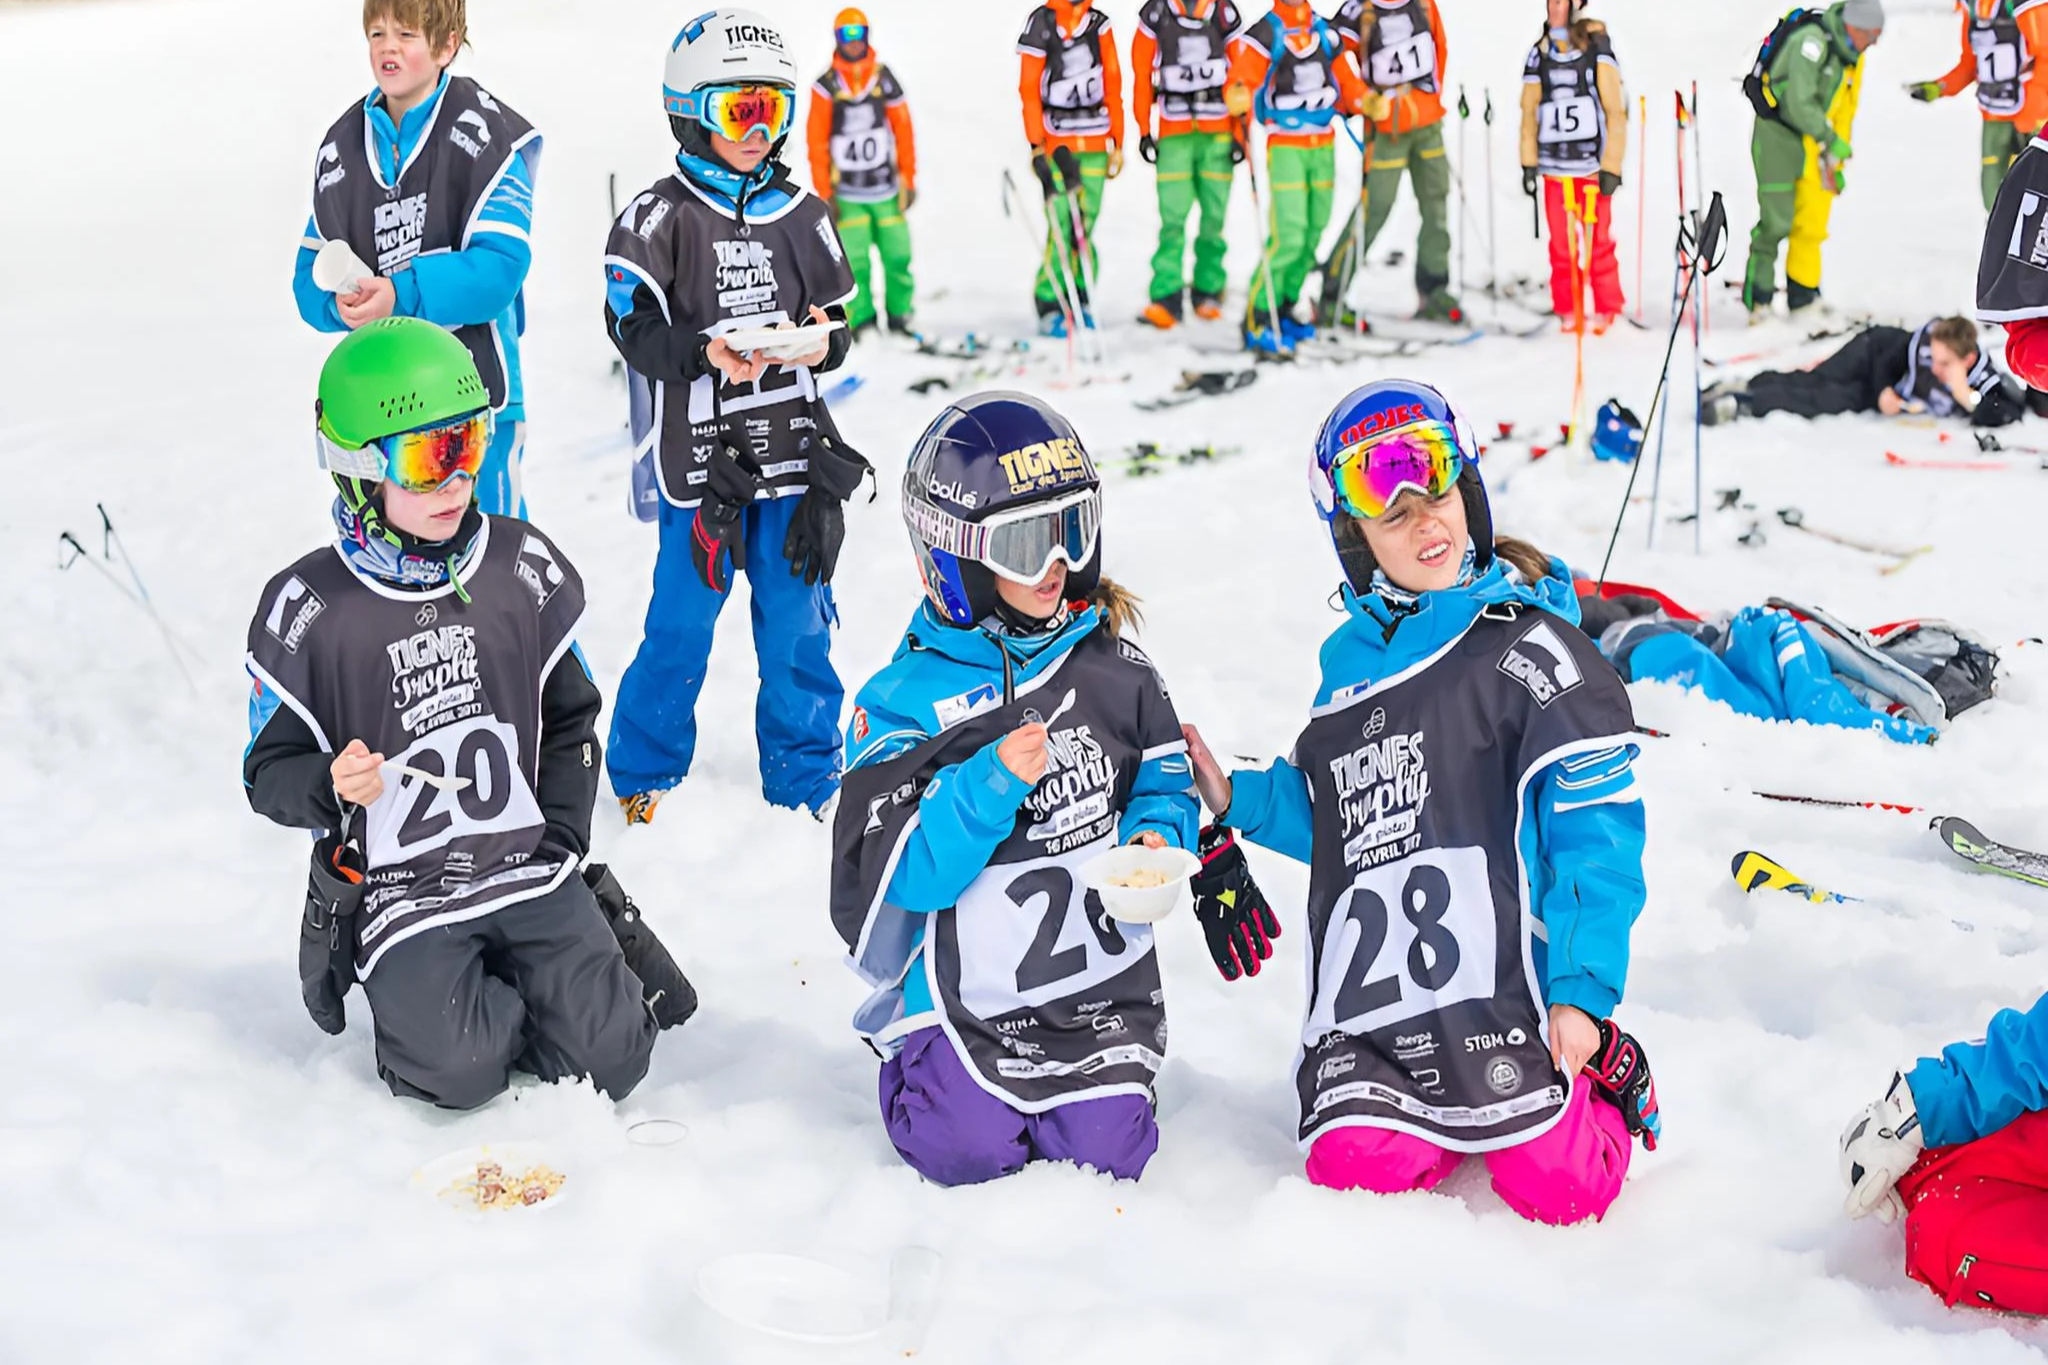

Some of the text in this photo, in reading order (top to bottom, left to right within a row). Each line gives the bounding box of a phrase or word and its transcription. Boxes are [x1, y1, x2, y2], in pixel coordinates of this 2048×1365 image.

[844, 135, 877, 163] 40
[998, 437, 1082, 486] TIGNES
[929, 473, 978, 510] bollé
[386, 624, 476, 674] TIGNES
[391, 645, 481, 709] Trophy
[1044, 724, 1104, 773] NES
[1329, 730, 1425, 796] TIGNES
[396, 727, 512, 848] 20
[1338, 758, 1432, 839] Trophy
[1360, 842, 1403, 869] AVRIL
[1333, 864, 1461, 1025] 28
